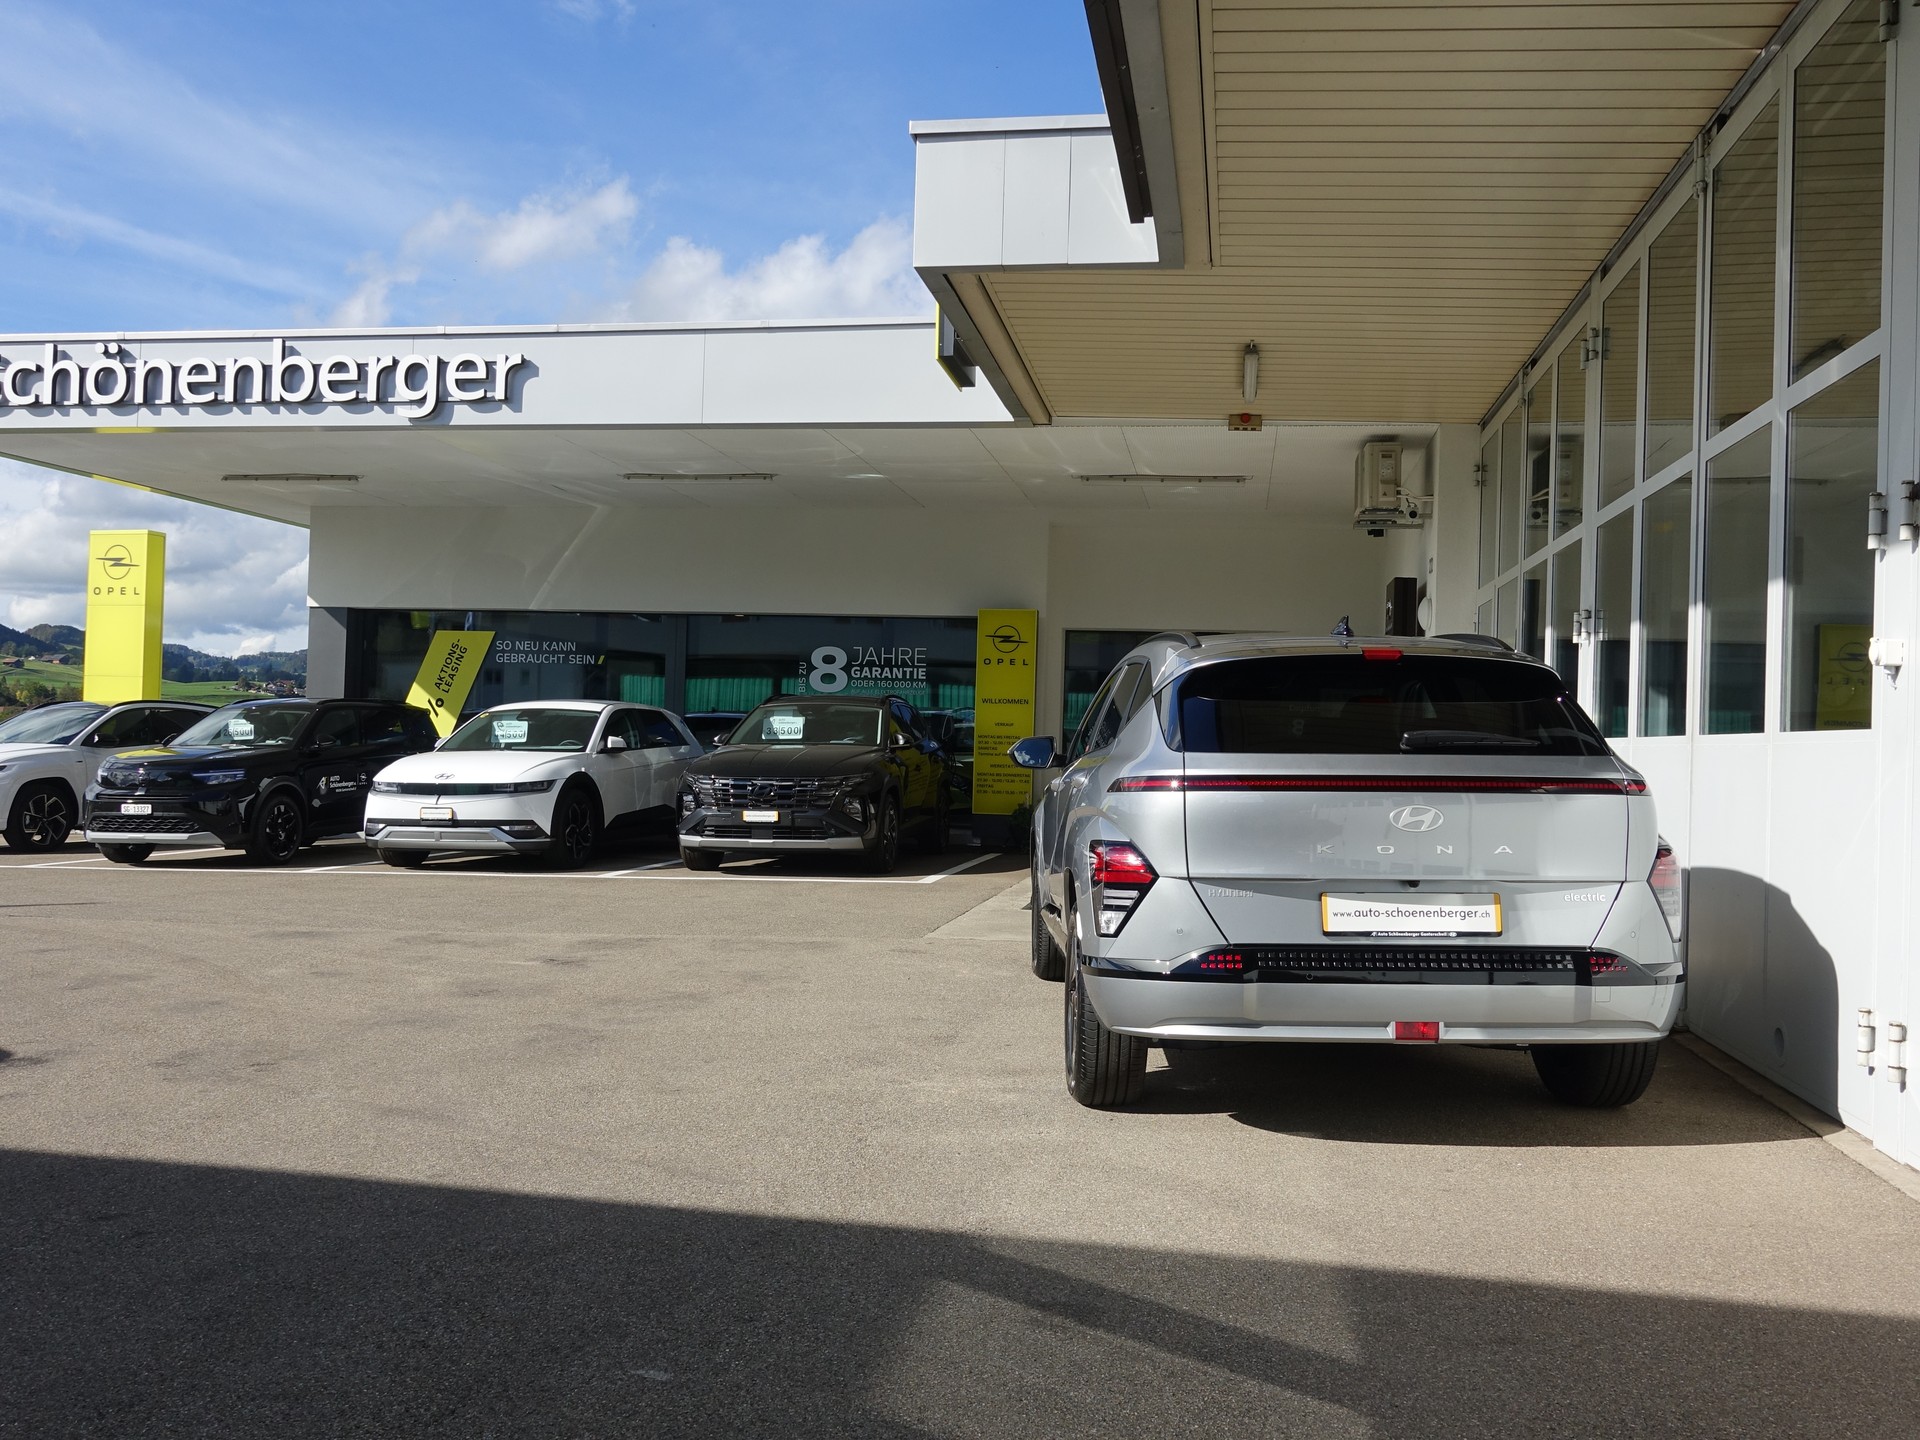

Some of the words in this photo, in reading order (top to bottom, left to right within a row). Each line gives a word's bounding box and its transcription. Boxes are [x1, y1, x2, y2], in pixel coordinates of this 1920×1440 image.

[0, 338, 524, 419] chönenberger
[93, 586, 141, 596] OPEL
[495, 640, 512, 651] SO
[515, 641, 540, 651] NEU
[543, 641, 576, 652] KANN
[495, 653, 565, 664] GEBRAUCHT
[568, 654, 595, 665] SEIN
[851, 646, 927, 666] JAHRE
[983, 657, 1029, 666] OPEL
[434, 637, 462, 690] AKTIONS-
[441, 645, 468, 694] LEASING
[798, 661, 807, 675] ZU
[808, 645, 848, 693] 8
[850, 666, 927, 680] GARANTIE
[798, 677, 807, 693] BIS
[850, 679, 875, 688] ODER
[877, 680, 892, 688] 160
[893, 681, 912, 689] 000
[912, 681, 927, 689] KM
[1316, 844, 1513, 855] KONA
[1207, 888, 1254, 897] HYUNDAI
[1563, 892, 1606, 903] electric
[1332, 907, 1491, 921] www.auto-schoenenberger.ch
